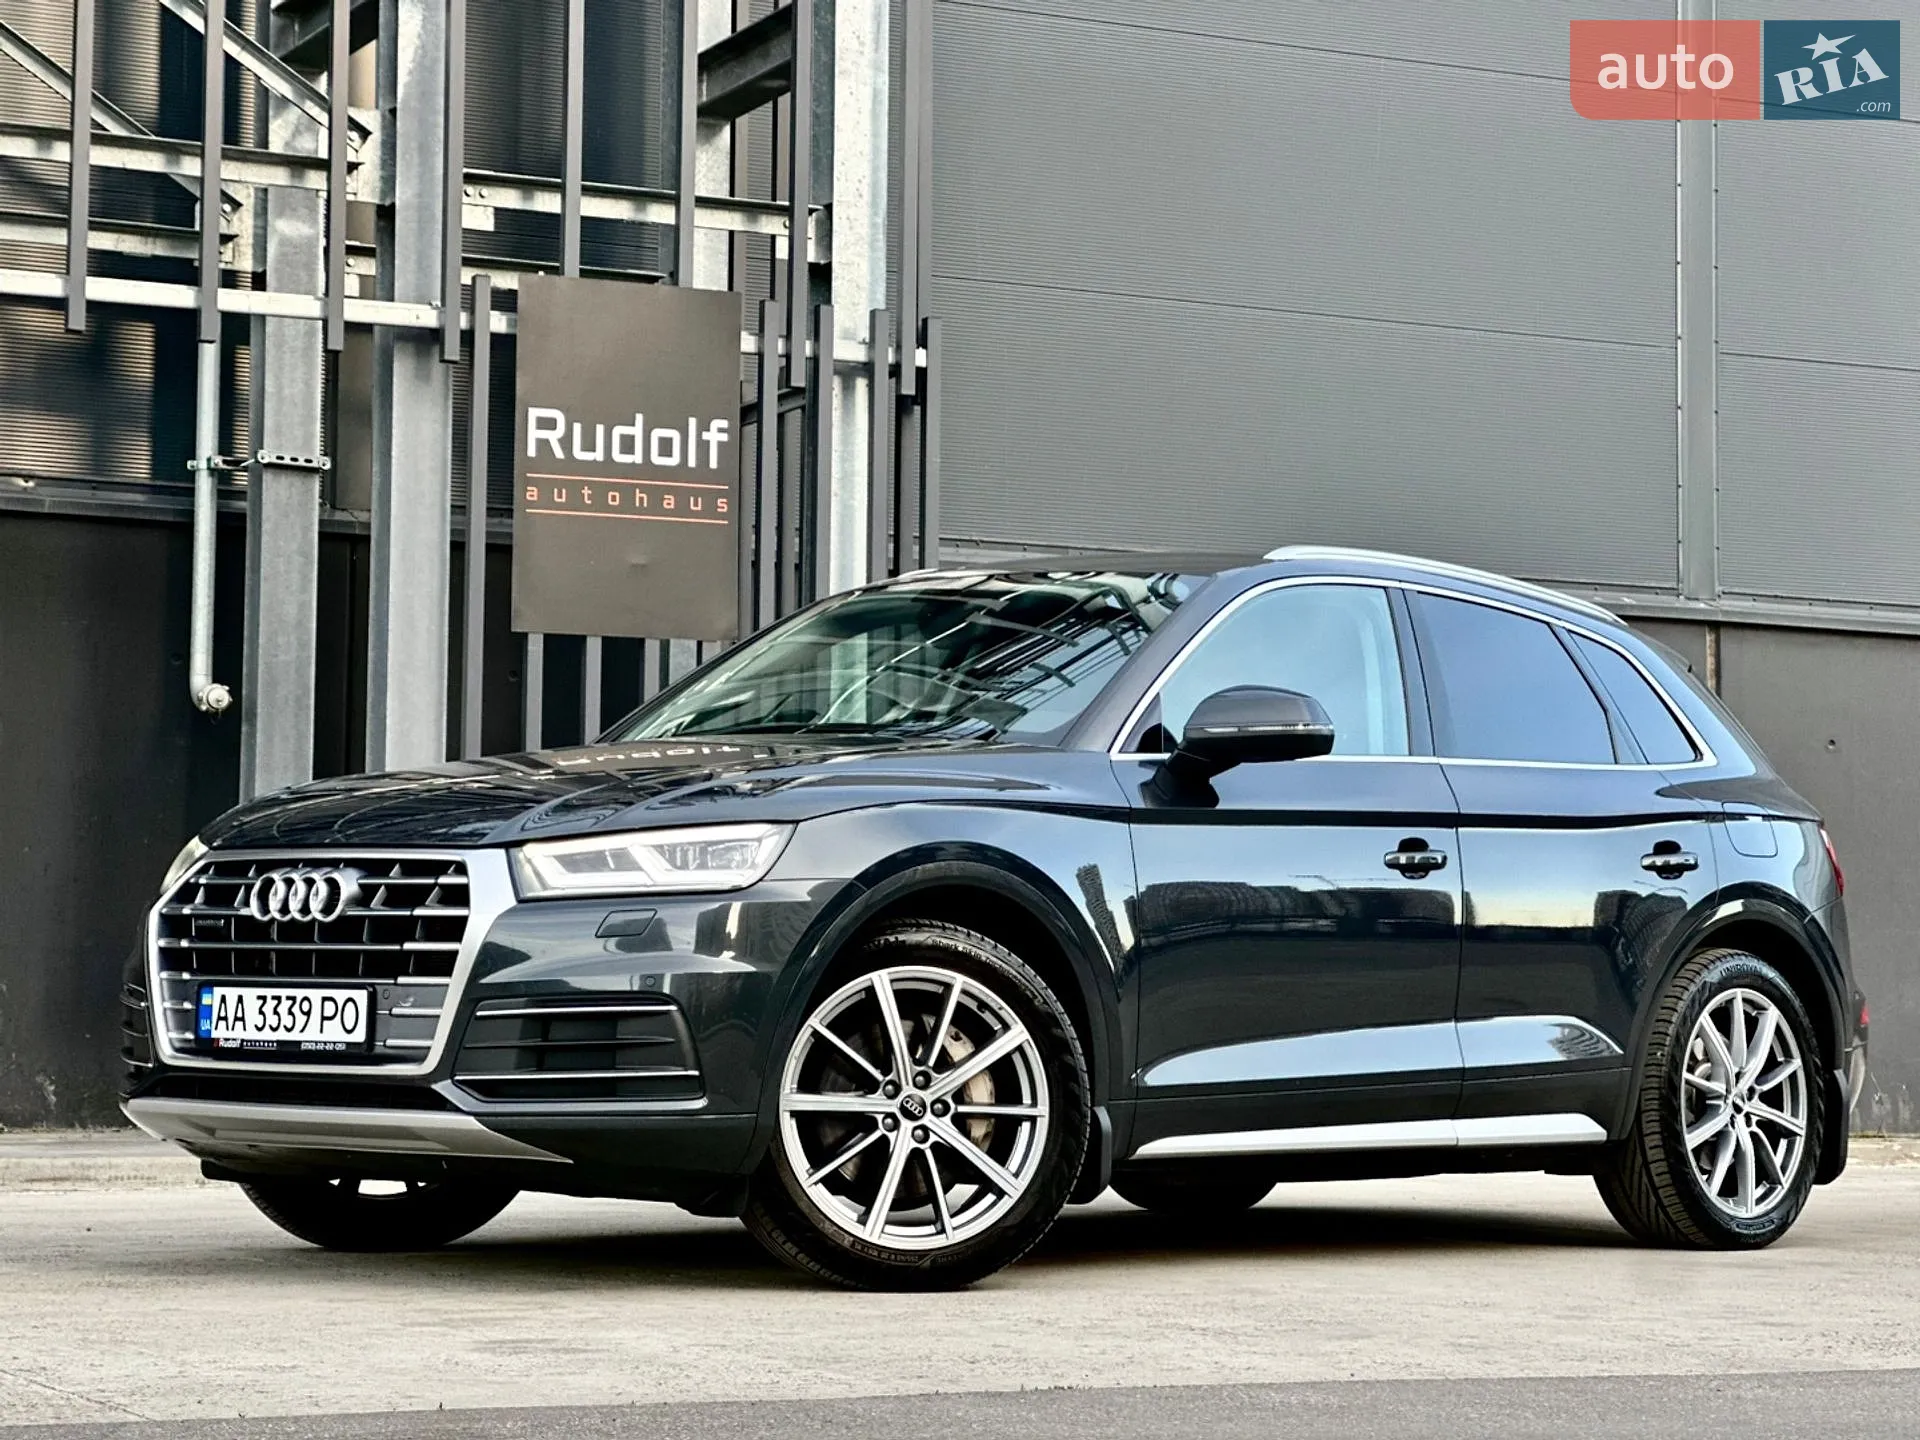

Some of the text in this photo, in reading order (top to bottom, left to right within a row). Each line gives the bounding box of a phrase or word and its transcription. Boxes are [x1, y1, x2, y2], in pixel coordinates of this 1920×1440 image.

[526, 406, 729, 470] Rudolf
[526, 486, 728, 512] autohaus
[214, 994, 360, 1035] AA 3339 PO
